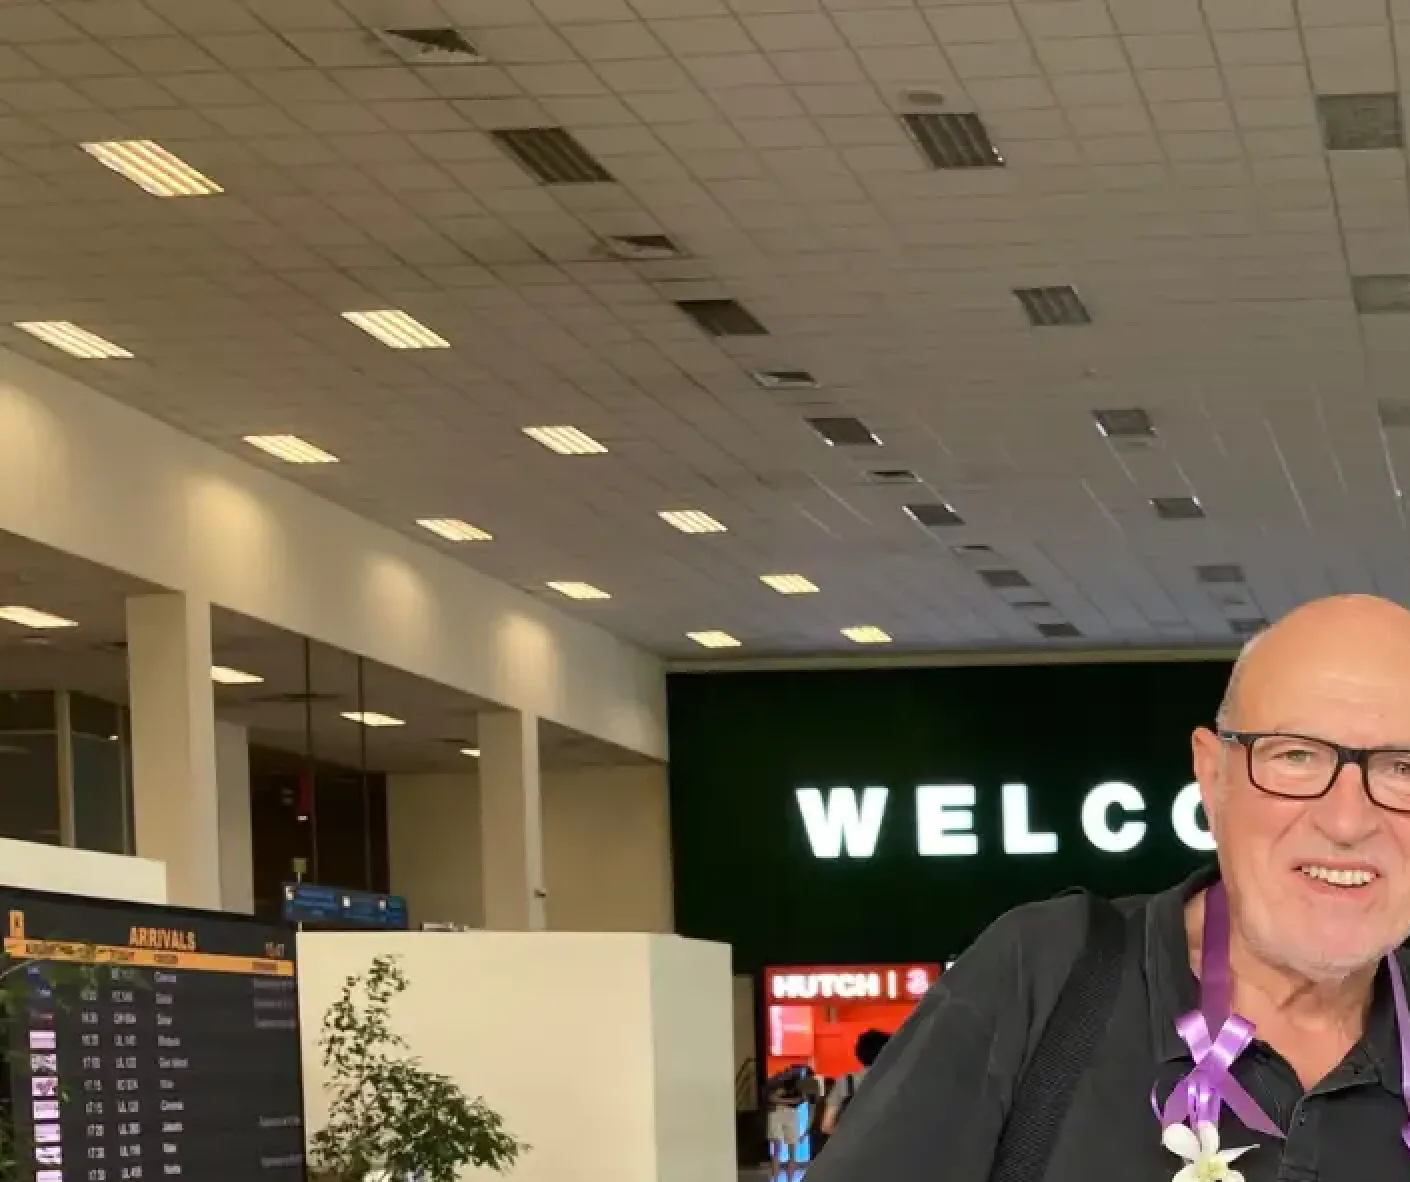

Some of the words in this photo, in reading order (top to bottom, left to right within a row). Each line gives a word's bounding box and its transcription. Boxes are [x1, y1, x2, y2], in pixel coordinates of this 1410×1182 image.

[796, 780, 1218, 859] WELCO
[129, 926, 196, 950] ARRIVALS
[772, 973, 881, 998] HUTCH
